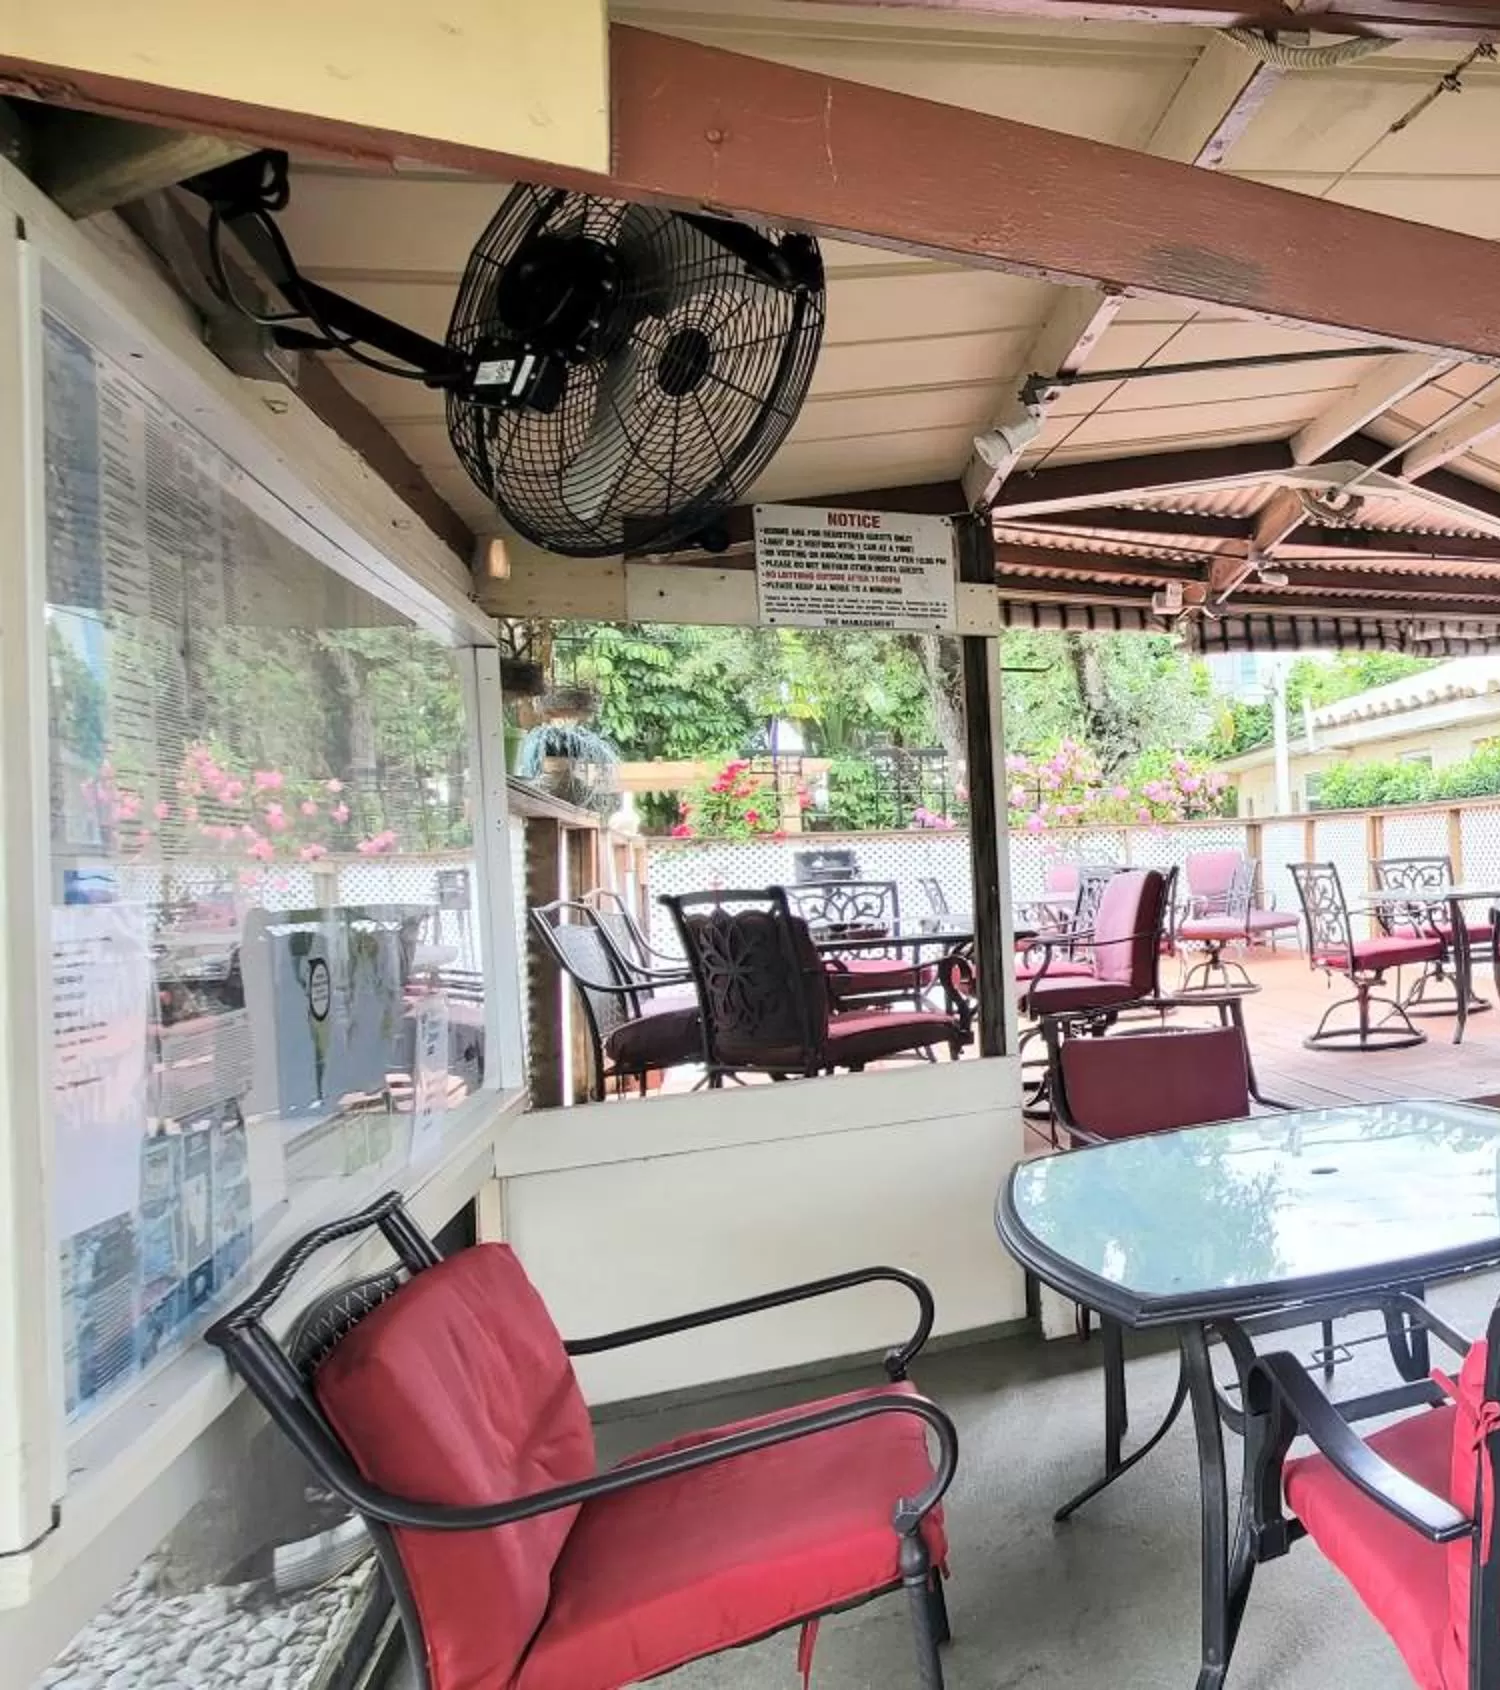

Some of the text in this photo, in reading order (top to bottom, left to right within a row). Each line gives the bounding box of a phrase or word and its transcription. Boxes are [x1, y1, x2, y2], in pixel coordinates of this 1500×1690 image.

[827, 512, 881, 528] NOTICE
[807, 529, 821, 537] FOR
[766, 560, 792, 568] PLEASE
[893, 556, 915, 564] AFTER
[765, 581, 793, 590] PLEASE
[841, 619, 895, 629] MANAGEMENT
